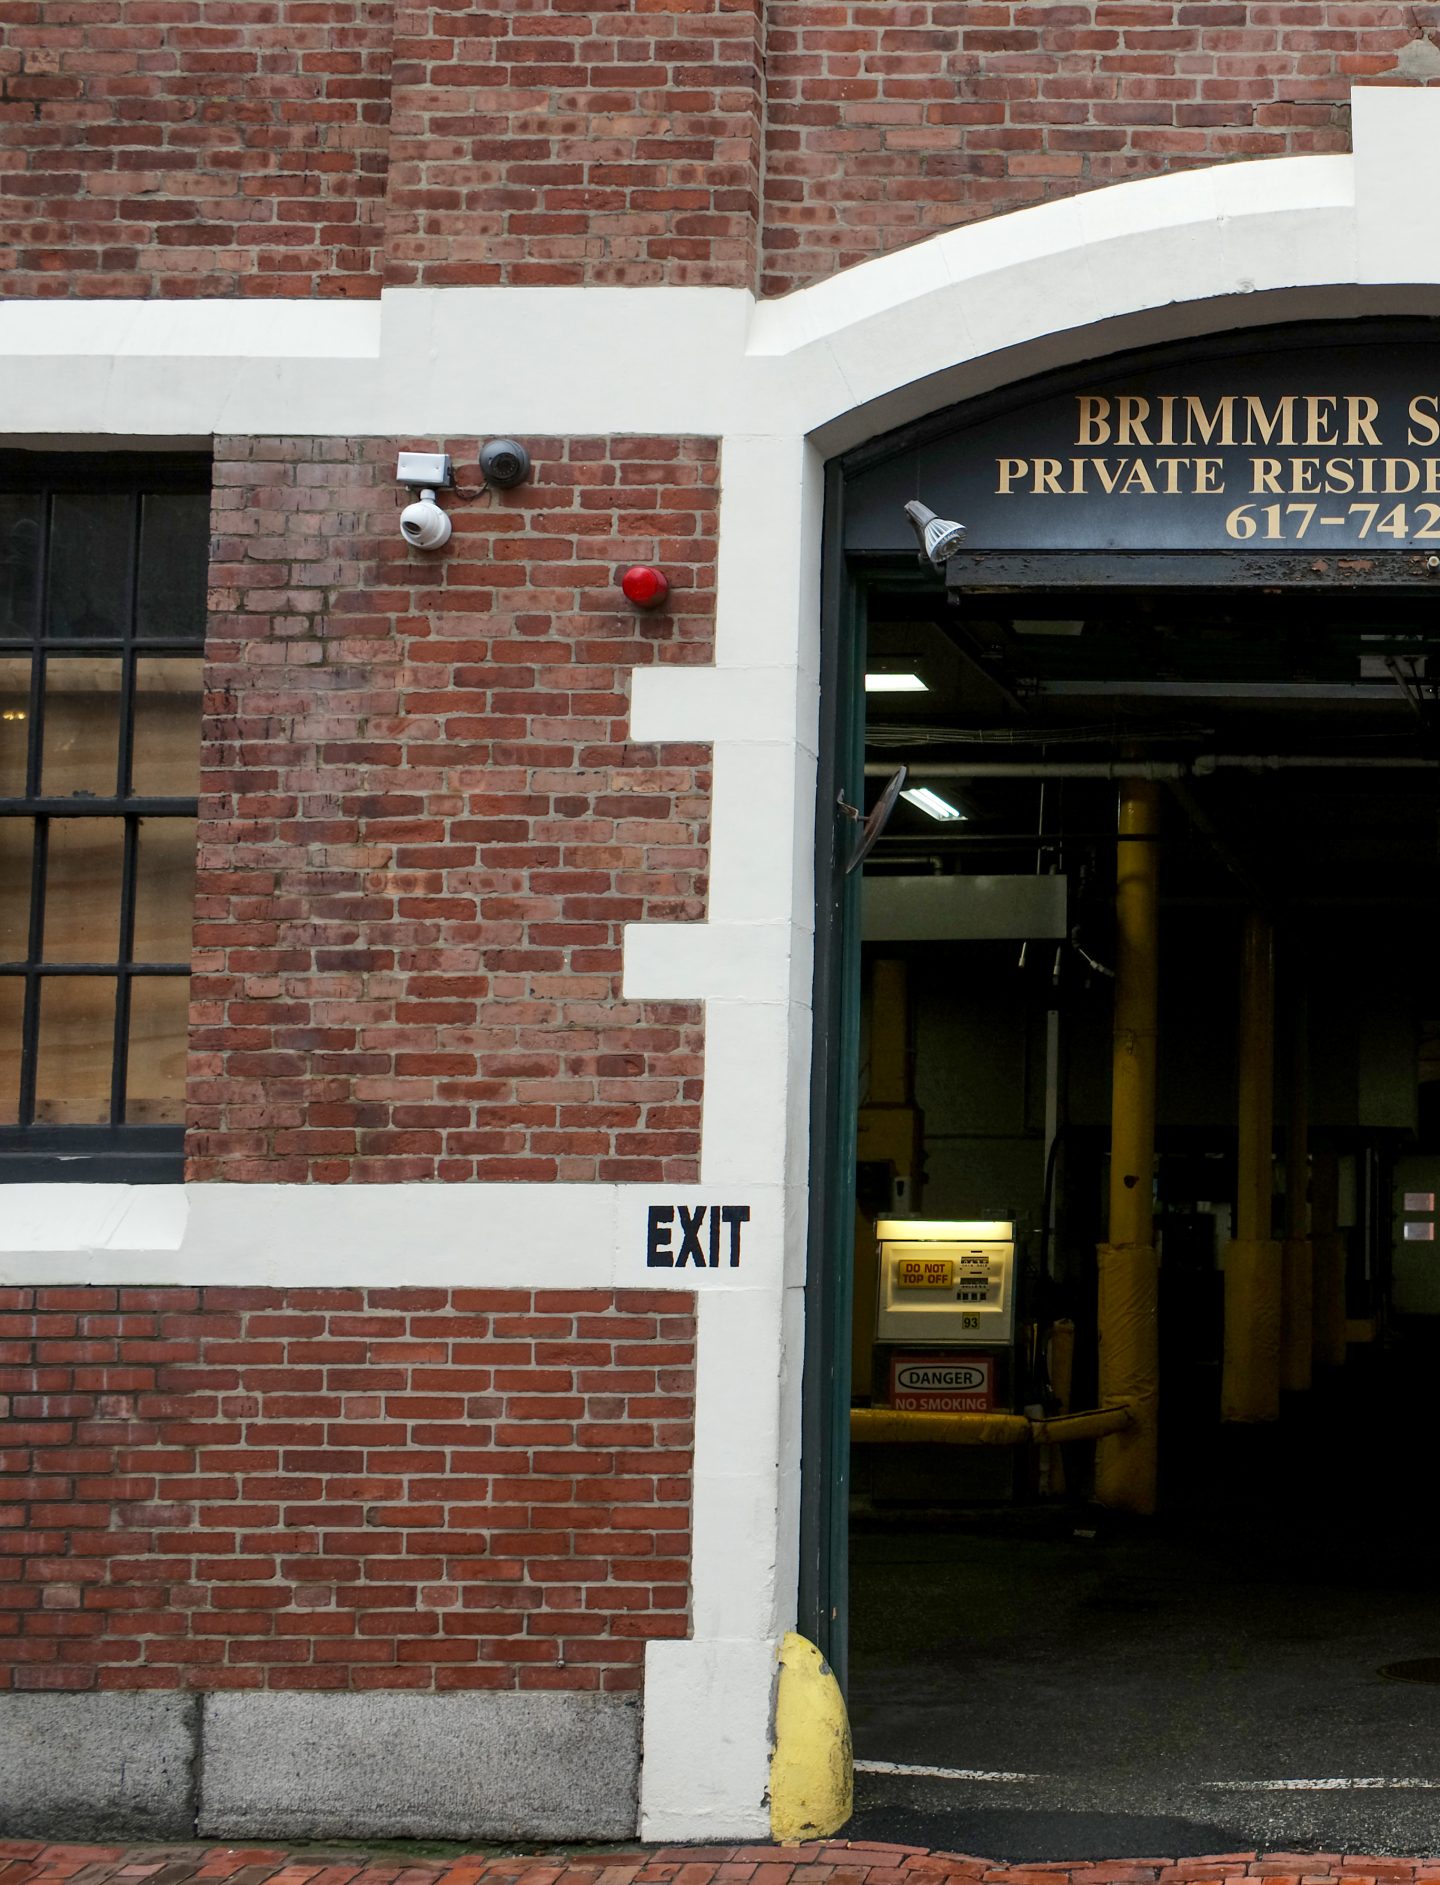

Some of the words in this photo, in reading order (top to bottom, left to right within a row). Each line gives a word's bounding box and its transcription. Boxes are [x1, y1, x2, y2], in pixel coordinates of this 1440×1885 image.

[1075, 395, 1381, 447] BRIMMER
[995, 457, 1225, 495] PRIVATE
[647, 1205, 751, 1268] EXIT
[905, 1263, 921, 1273] DO
[924, 1263, 946, 1273] NOT
[903, 1274, 924, 1284] TOP
[927, 1274, 949, 1284] OFF
[963, 1317, 978, 1328] 93
[909, 1372, 973, 1385] DANGER
[895, 1398, 917, 1410] NO
[920, 1398, 987, 1411] SMOKING
